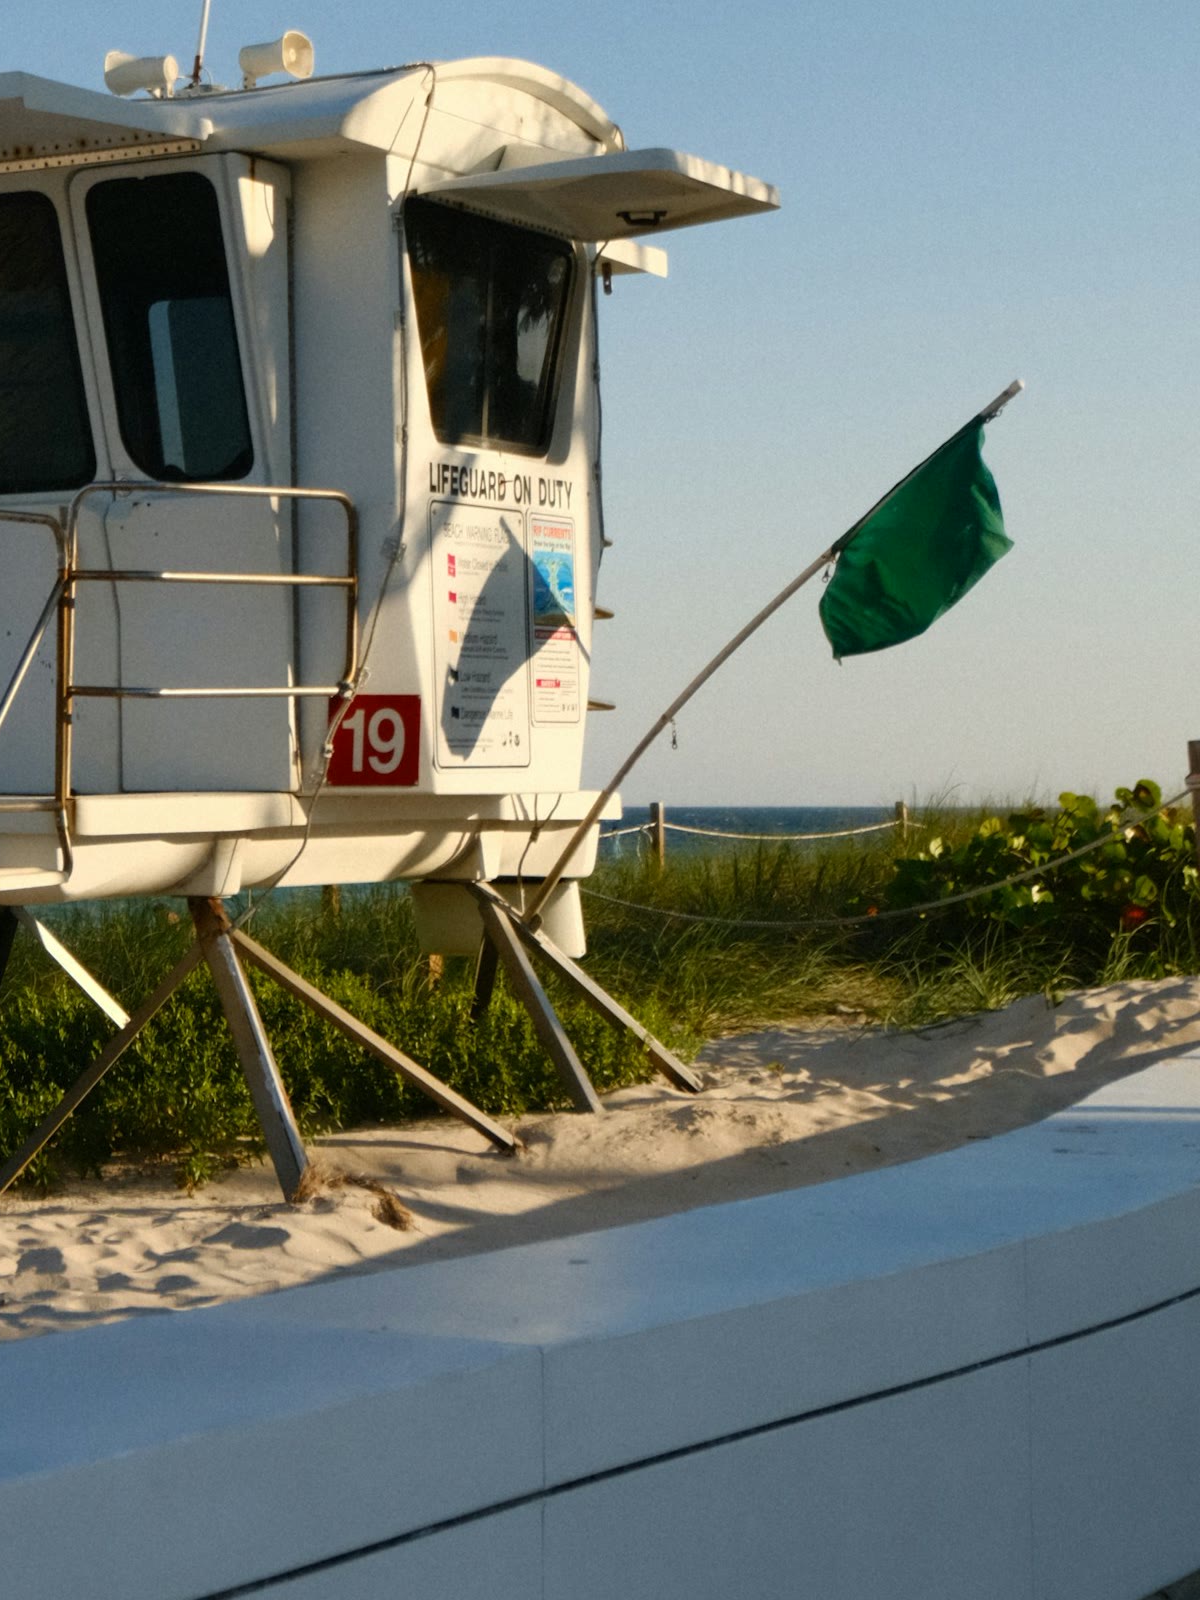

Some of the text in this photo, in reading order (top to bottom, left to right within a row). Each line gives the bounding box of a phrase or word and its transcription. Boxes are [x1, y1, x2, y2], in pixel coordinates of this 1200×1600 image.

[429, 462, 572, 509] LIFEGUARD ON DUTY
[341, 707, 406, 774] 19
